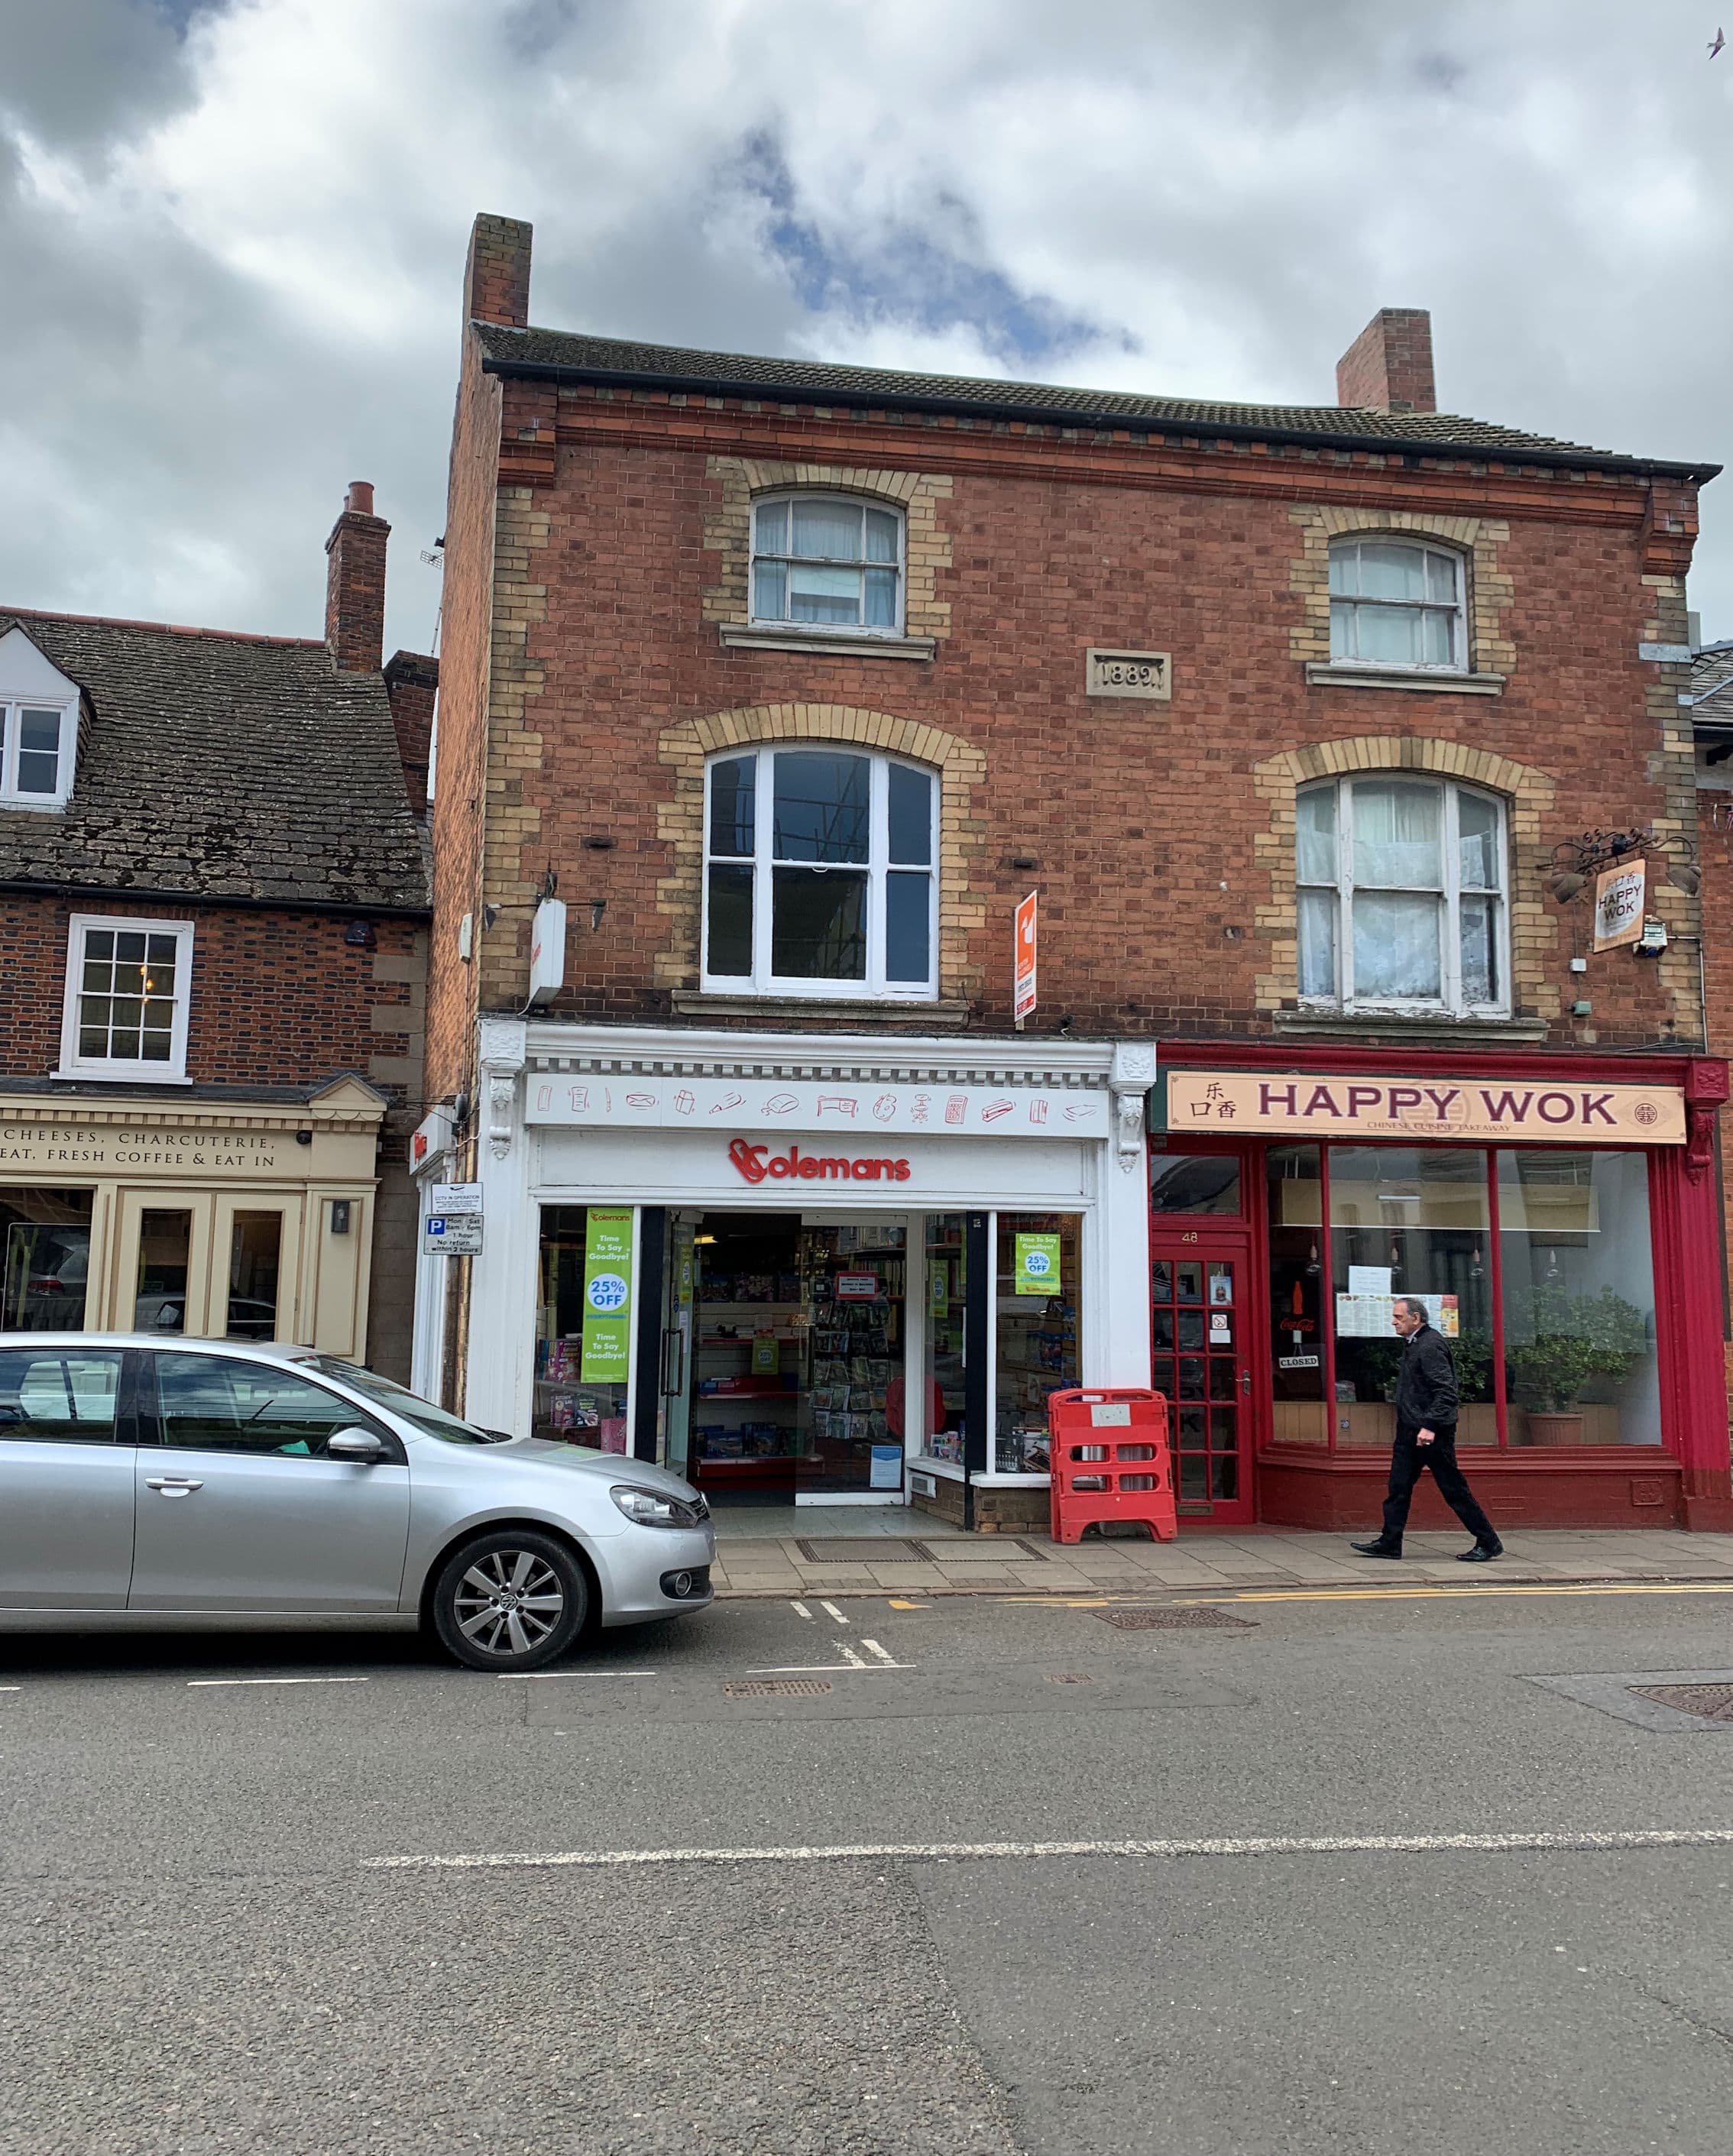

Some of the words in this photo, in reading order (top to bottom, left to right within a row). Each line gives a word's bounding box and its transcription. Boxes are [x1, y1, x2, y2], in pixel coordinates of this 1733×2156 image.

[1599, 884, 1641, 909] HAPPY
[1605, 901, 1635, 921] WOK
[1258, 1083, 1461, 1121] HAPPY
[1479, 1089, 1618, 1125] WOK
[4, 1129, 105, 1143] CHEESES,
[118, 1133, 274, 1149] CHARCUTERIE,
[47, 1149, 105, 1161] FRESH
[115, 1151, 183, 1164] COFFEE
[193, 1153, 206, 1164] &
[215, 1155, 245, 1165] EAT
[255, 1156, 274, 1166] IN
[729, 1138, 911, 1183] Colemans
[431, 1220, 442, 1233] P
[1182, 1232, 1198, 1243] 48
[589, 1253, 629, 1261] Goodbye!
[1027, 1256, 1048, 1264] 25%
[591, 1281, 625, 1293] 25%
[594, 1295, 621, 1305] OFF
[585, 1352, 625, 1360] Goodbye!
[1281, 1358, 1317, 1367] CLOSED
